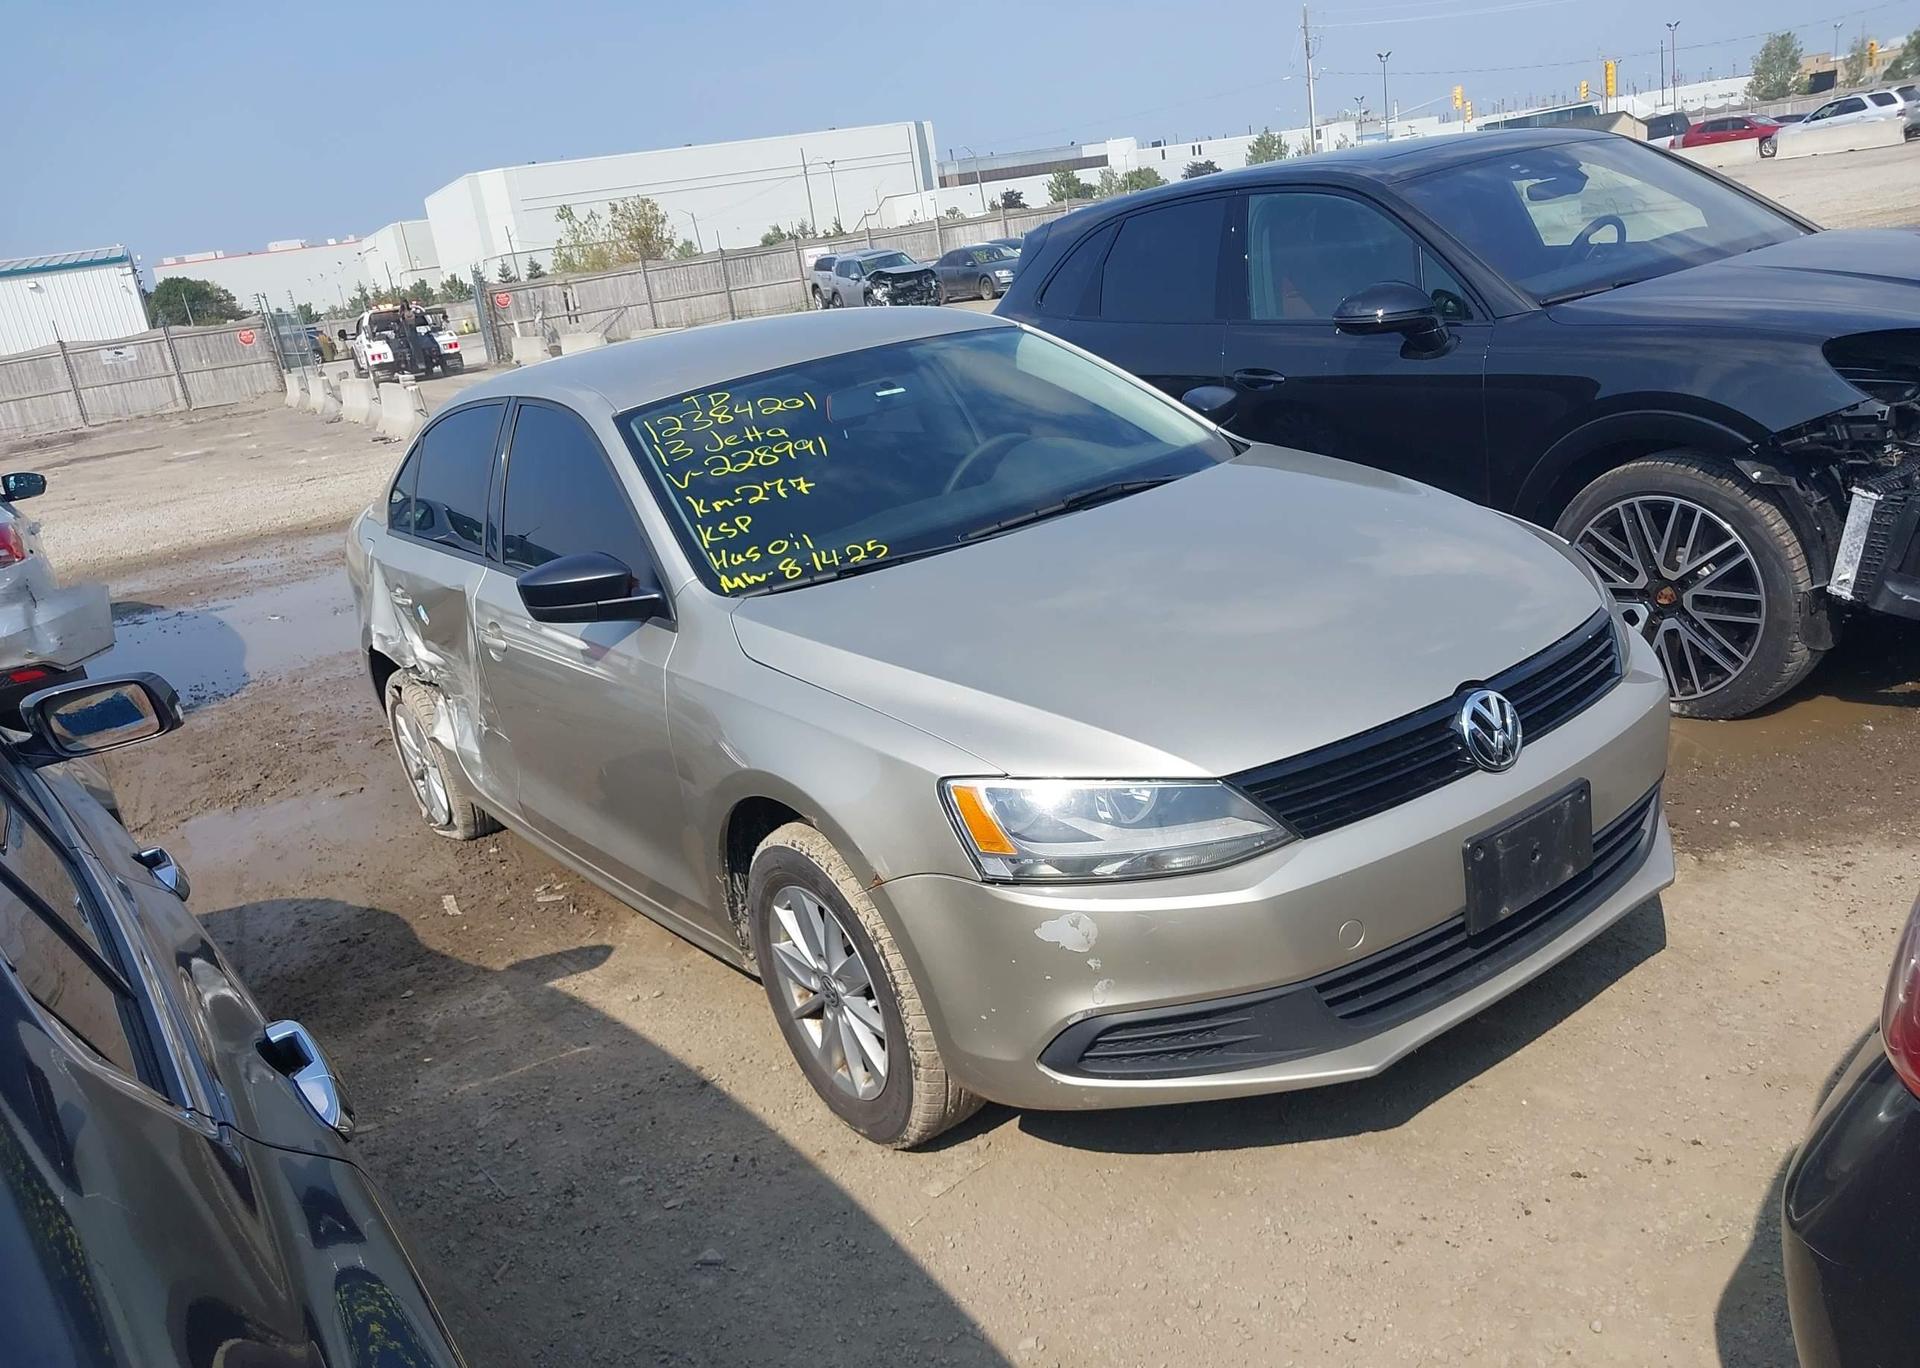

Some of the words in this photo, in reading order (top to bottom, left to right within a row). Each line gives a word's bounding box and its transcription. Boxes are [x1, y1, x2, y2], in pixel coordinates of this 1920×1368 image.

[643, 392, 817, 444] 12384201
[653, 439, 694, 467] 13
[704, 425, 790, 453] Jetta
[696, 515, 752, 549] KSP
